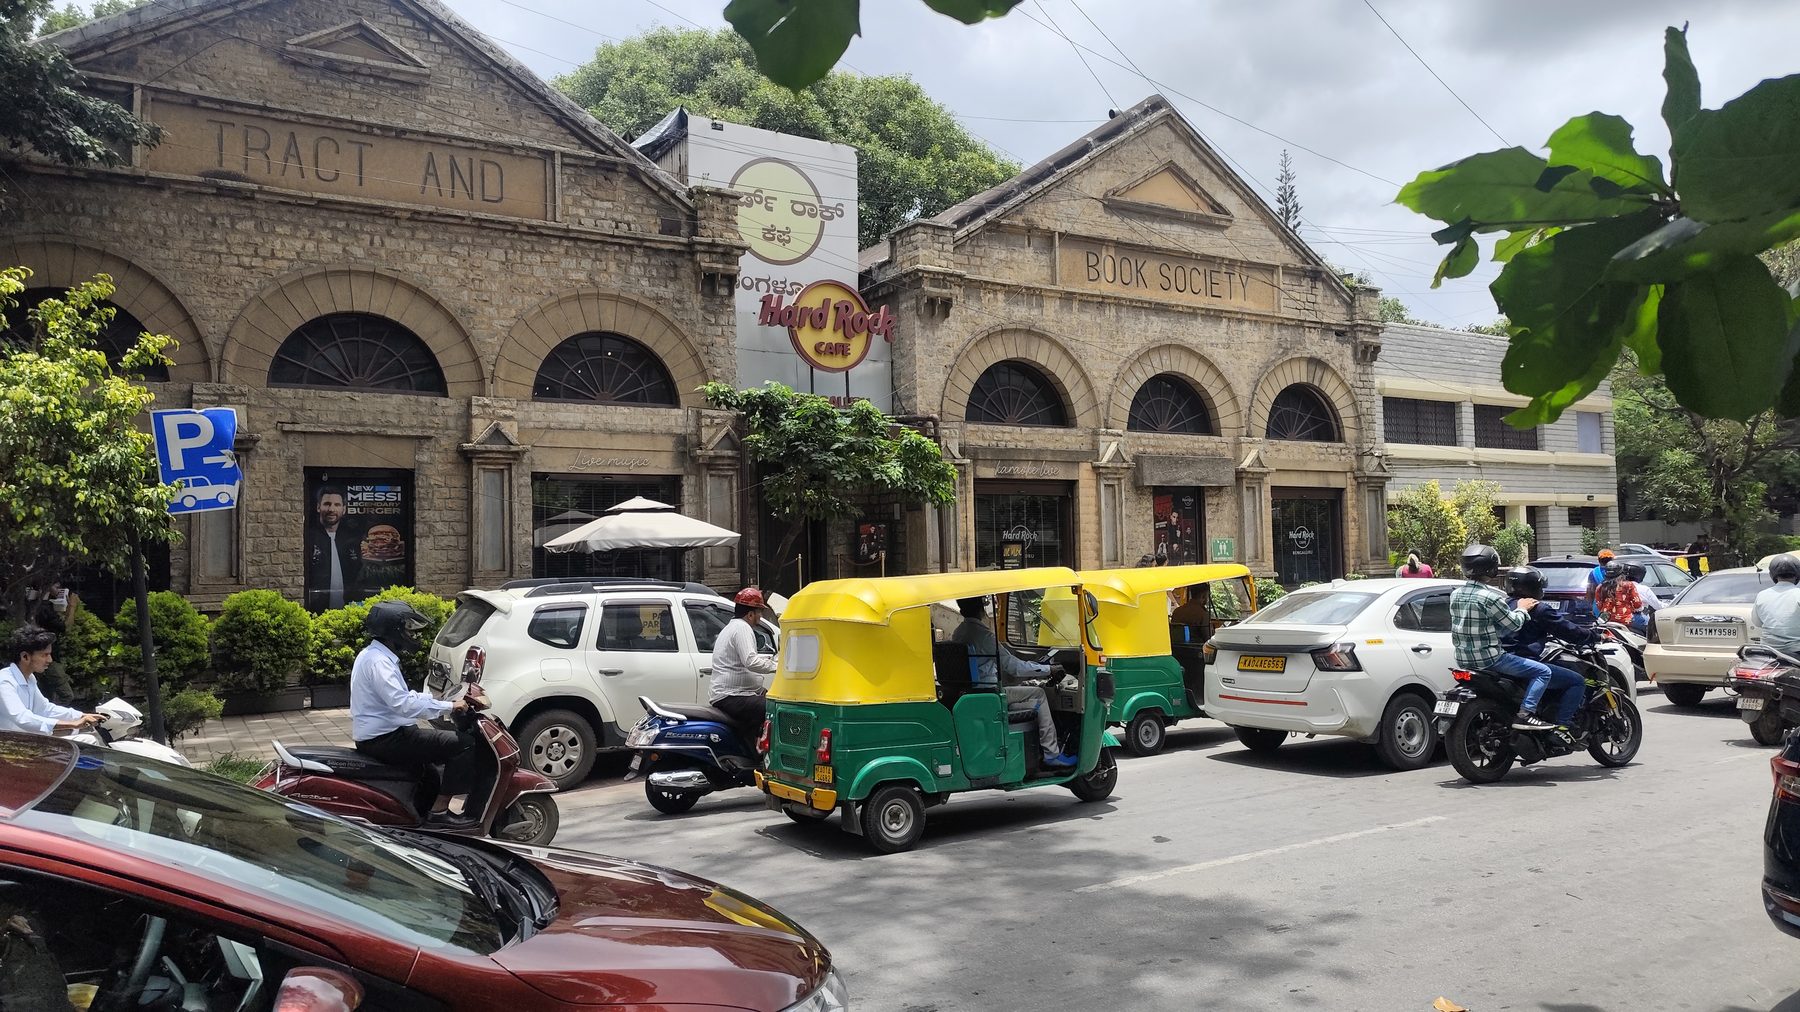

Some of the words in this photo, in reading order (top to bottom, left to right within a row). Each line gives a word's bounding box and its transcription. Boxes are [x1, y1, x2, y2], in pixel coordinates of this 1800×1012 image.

[206, 119, 373, 187] TRACT
[420, 151, 504, 204] AND
[1085, 251, 1148, 289] BOOK
[1159, 262, 1250, 302] SOCIETY
[758, 293, 832, 329] Hard
[833, 299, 898, 343] Rock
[814, 341, 851, 356] CAFE
[162, 413, 215, 471] P
[568, 448, 603, 471] Live
[606, 455, 651, 470] music
[347, 492, 401, 502] MESSI
[347, 507, 401, 515] BURGER
[1002, 530, 1020, 540] Hard
[1020, 530, 1038, 542] Rock
[1288, 530, 1302, 539] Hard
[1302, 530, 1315, 540] Rock
[1689, 627, 1737, 637] KA51MY9588
[1553, 730, 1571, 744] FILA
